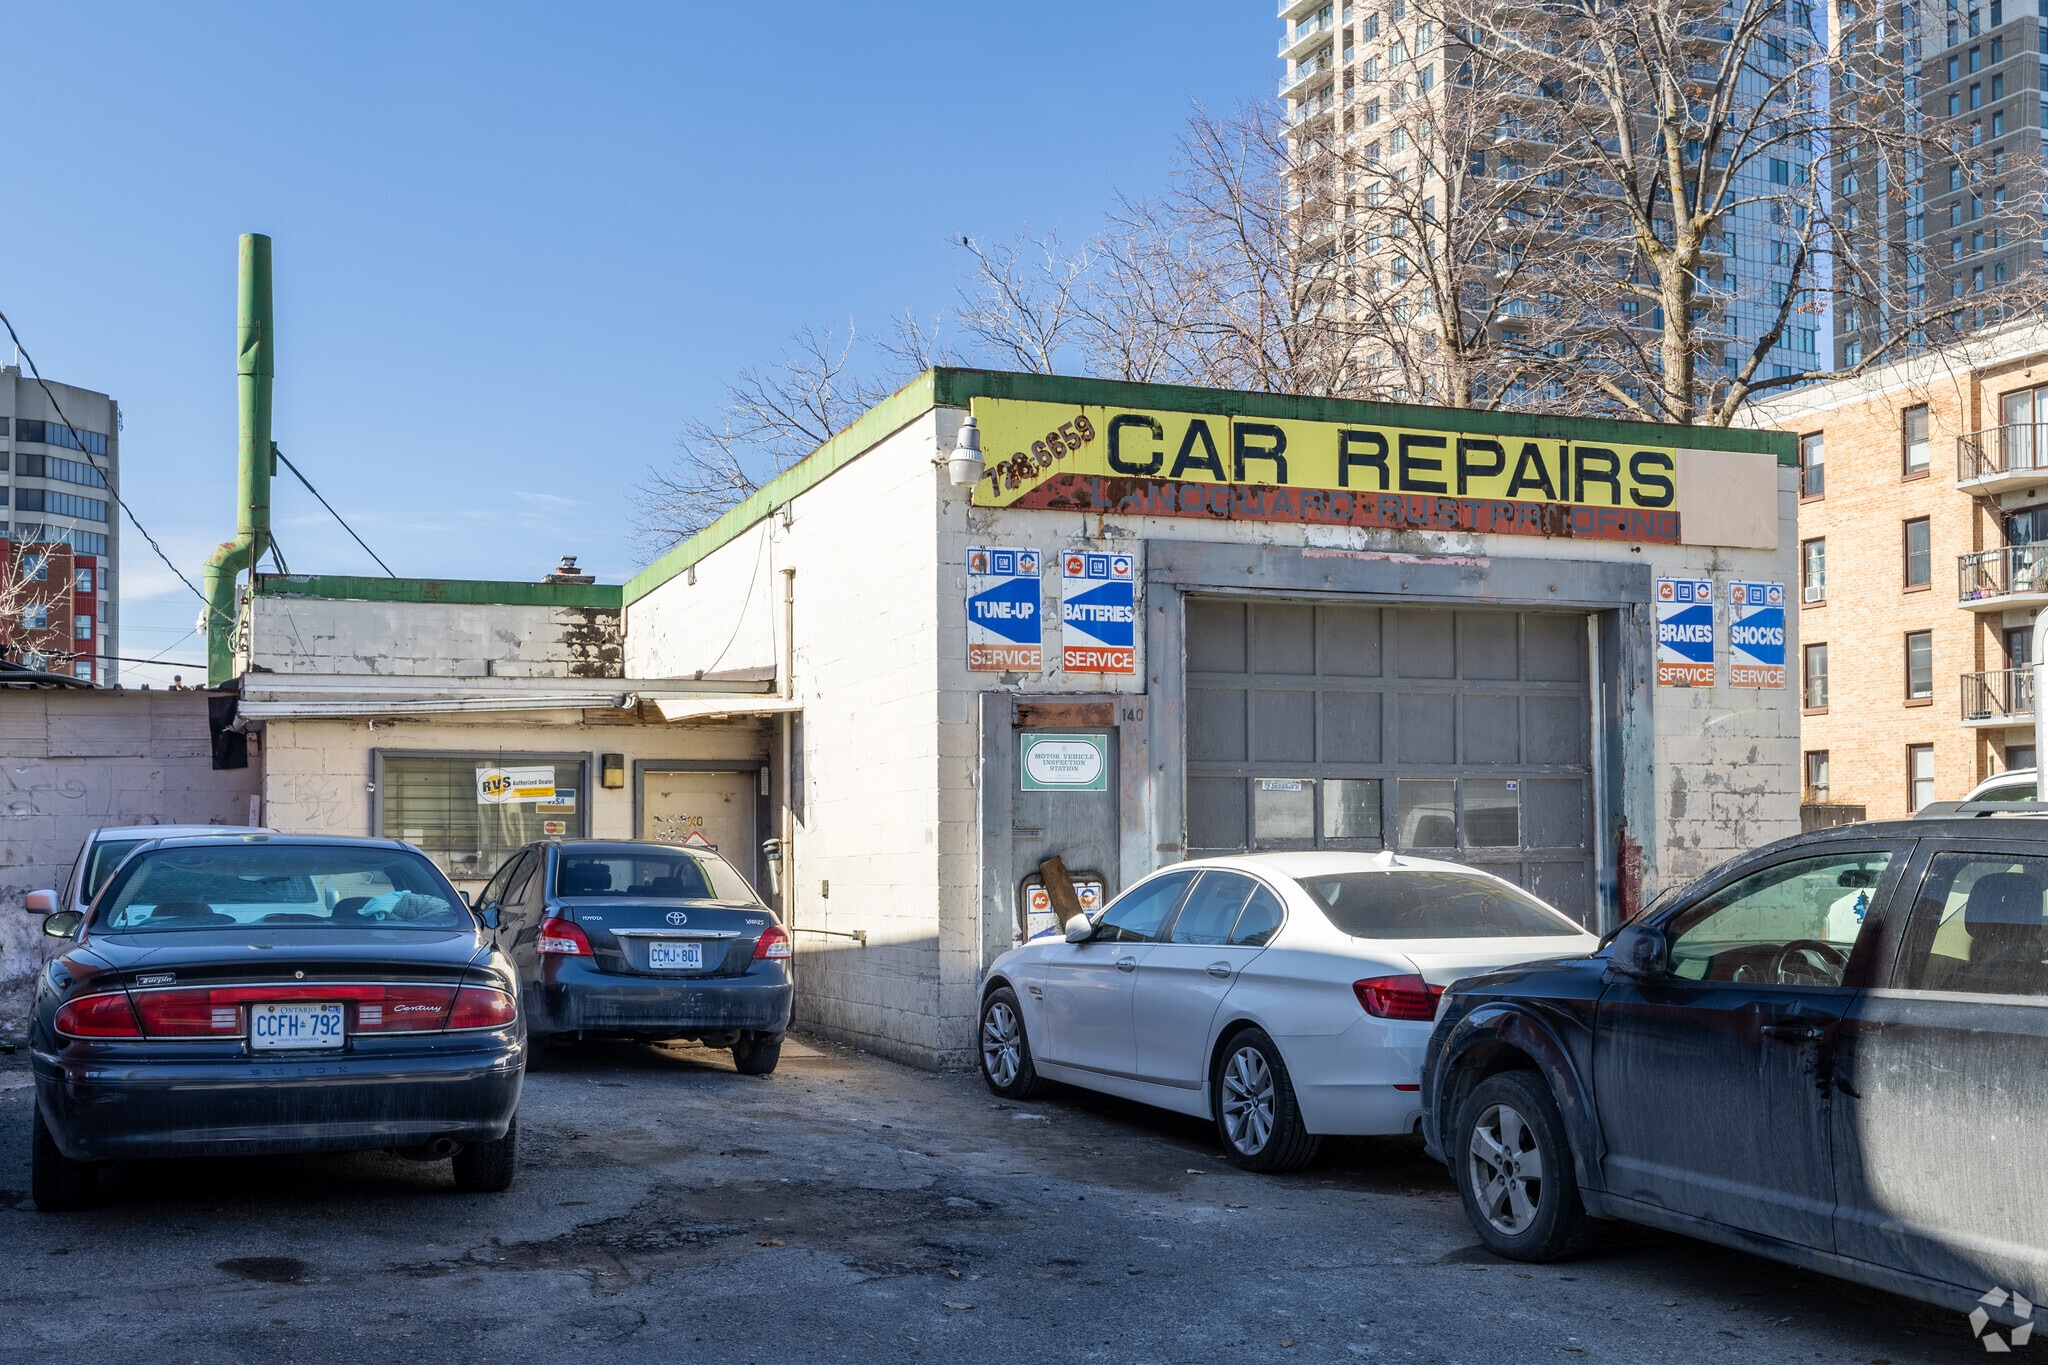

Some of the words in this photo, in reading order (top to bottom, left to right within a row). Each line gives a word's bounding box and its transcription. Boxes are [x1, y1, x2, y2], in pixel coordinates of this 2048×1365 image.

[1107, 414, 1288, 485] CAR
[1337, 429, 1675, 508] REPAIRS
[1069, 561, 1080, 570] AC
[975, 601, 1034, 619] TUNE-UP
[1063, 603, 1134, 623] BATTERIES
[1659, 624, 1713, 643] BRAKES
[1731, 626, 1784, 645] SHOCKS
[970, 650, 1041, 666] SERVICE
[1064, 651, 1134, 668] SERVICE
[1659, 668, 1714, 682] SERVICE
[1731, 670, 1784, 683] SERVICE
[1122, 708, 1144, 722] 140
[482, 776, 511, 792] RVS
[1034, 897, 1047, 905] AC
[651, 949, 676, 962] CCMJ
[681, 949, 699, 963] 801
[280, 1006, 317, 1015] ONTARIO
[393, 1003, 443, 1013] Century
[257, 1014, 299, 1037] CCFH
[310, 1014, 340, 1036] 792
